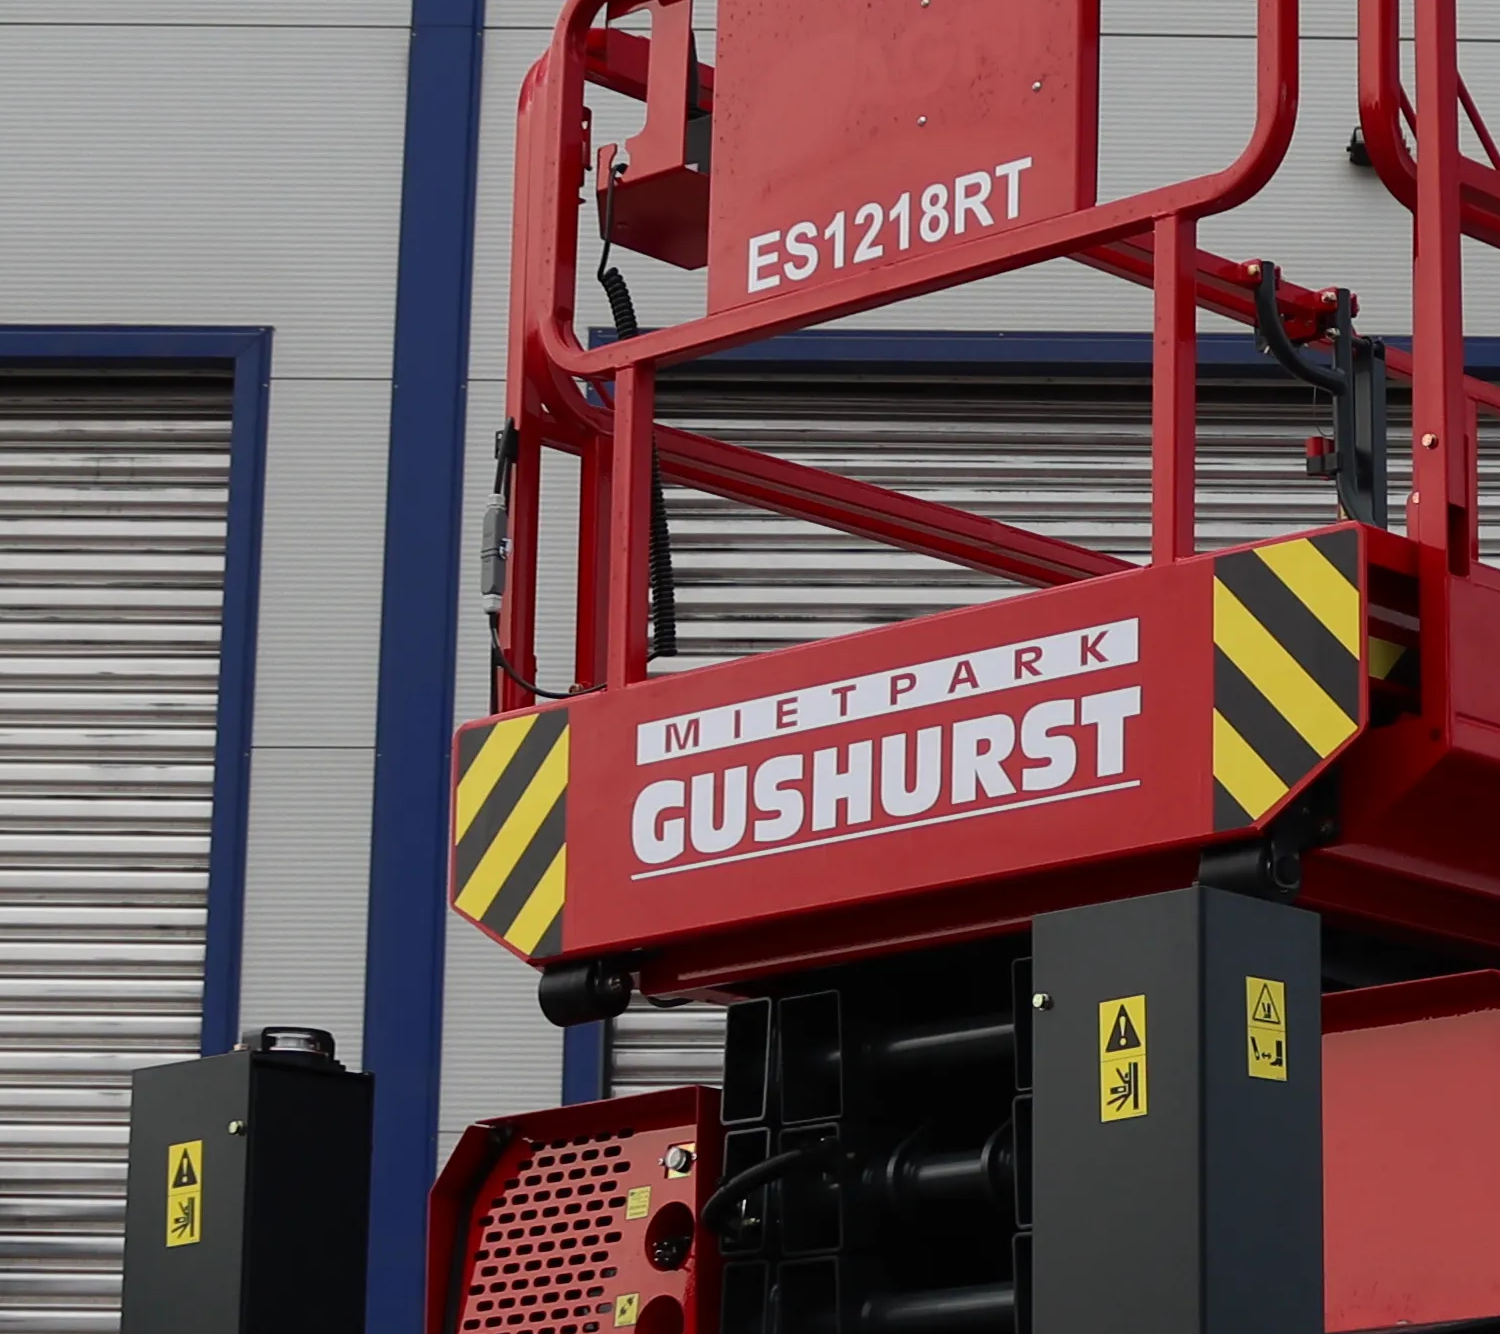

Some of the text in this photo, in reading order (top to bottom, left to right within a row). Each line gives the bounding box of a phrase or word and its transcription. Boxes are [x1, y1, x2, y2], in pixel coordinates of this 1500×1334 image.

[747, 156, 1033, 294] ES1218RT
[664, 630, 1109, 754] MIETPARK
[630, 685, 1143, 865] GUSHURST
